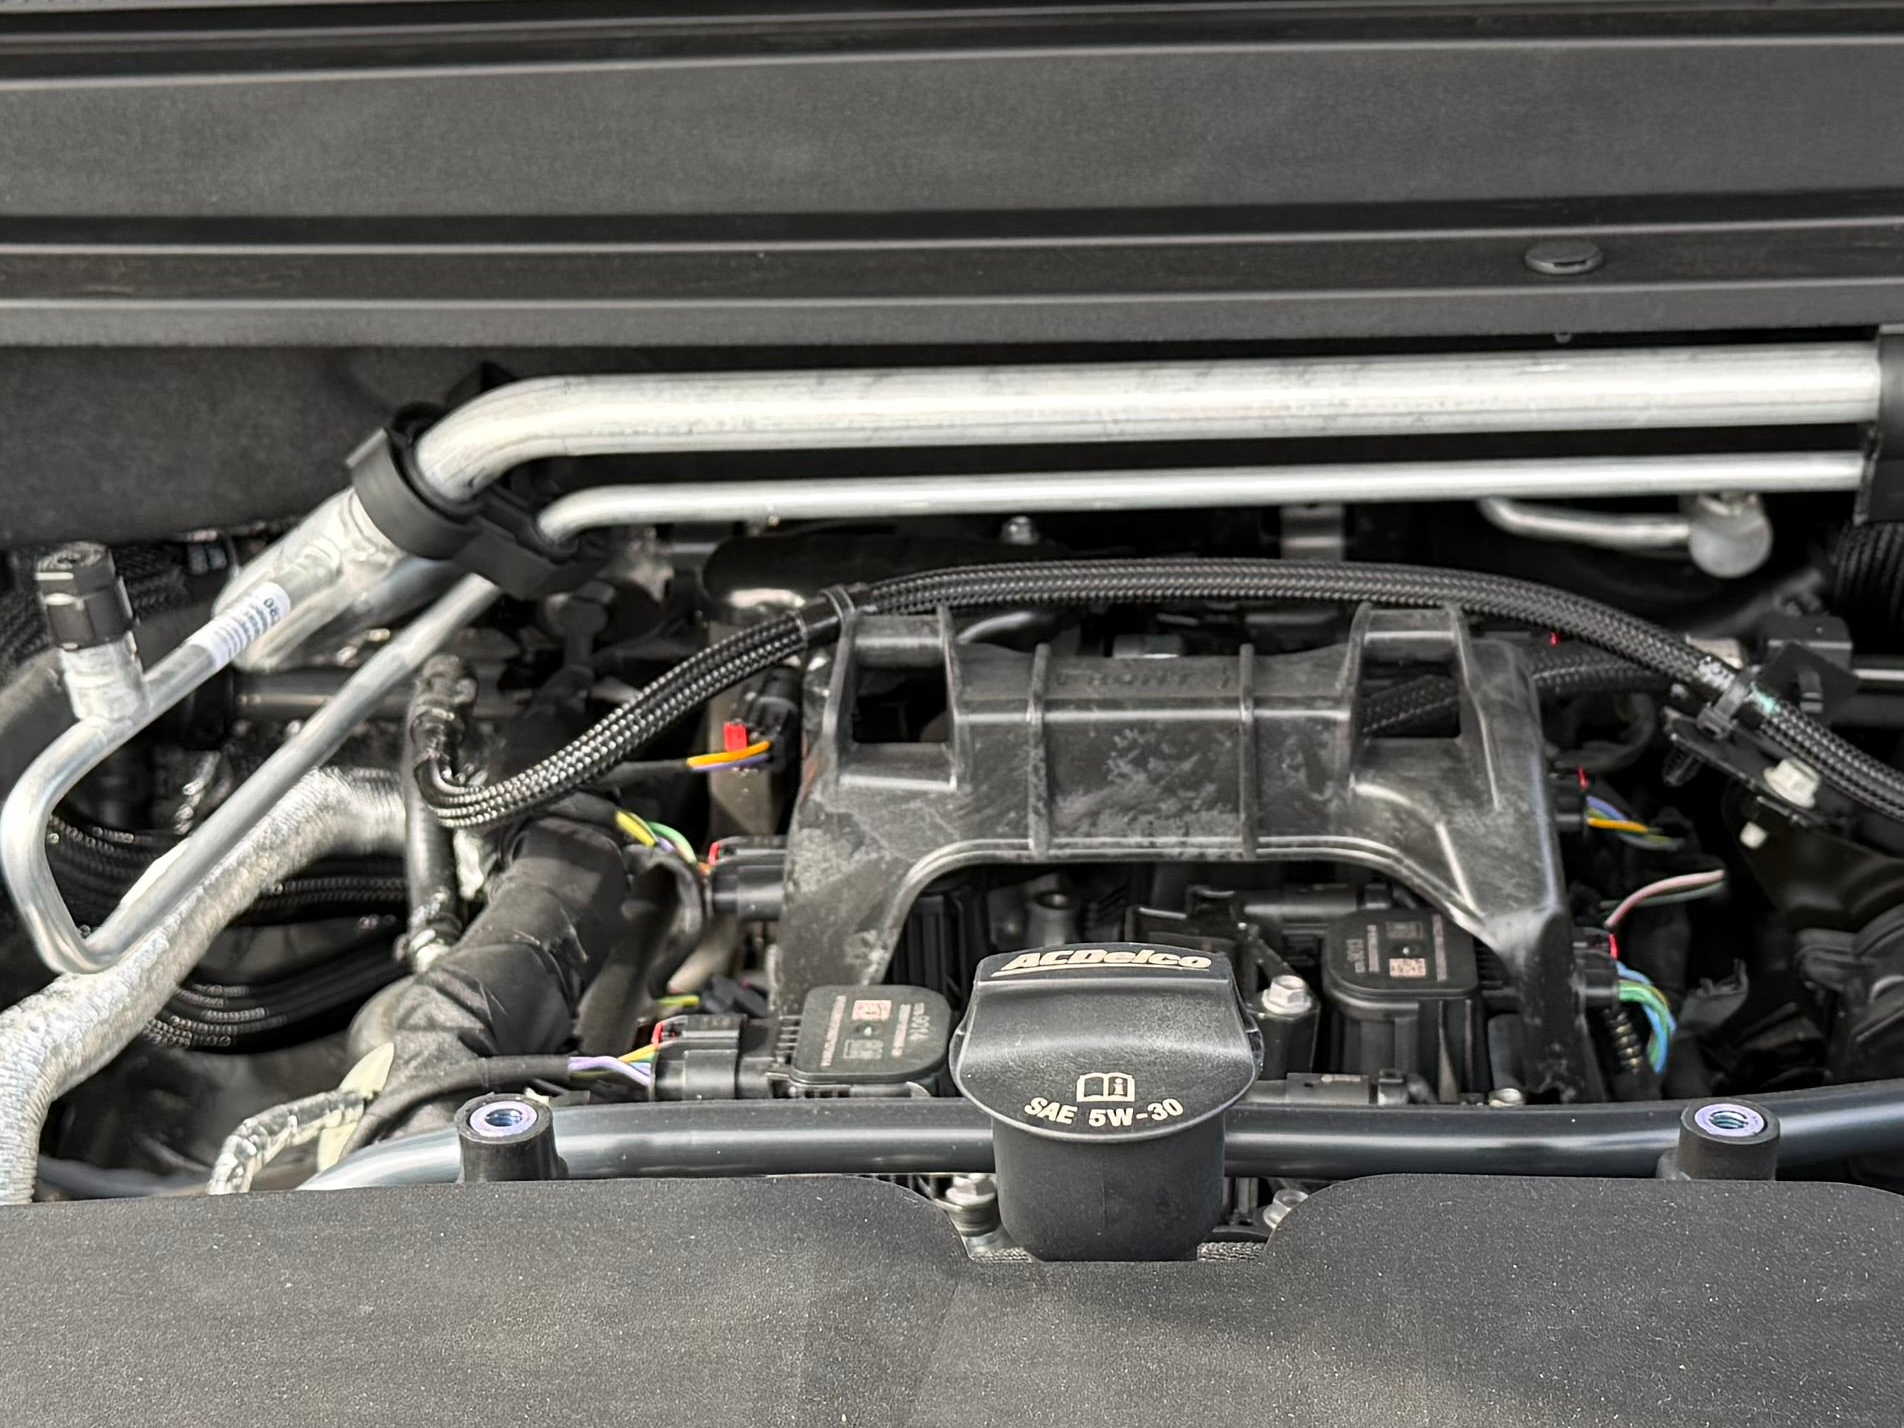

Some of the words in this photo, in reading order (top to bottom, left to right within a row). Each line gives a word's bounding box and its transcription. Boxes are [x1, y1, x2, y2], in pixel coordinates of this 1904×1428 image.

[1000, 949, 1213, 971] ACDelco
[1024, 1097, 1078, 1125] SAE
[1088, 1097, 1184, 1127] 5W-30
